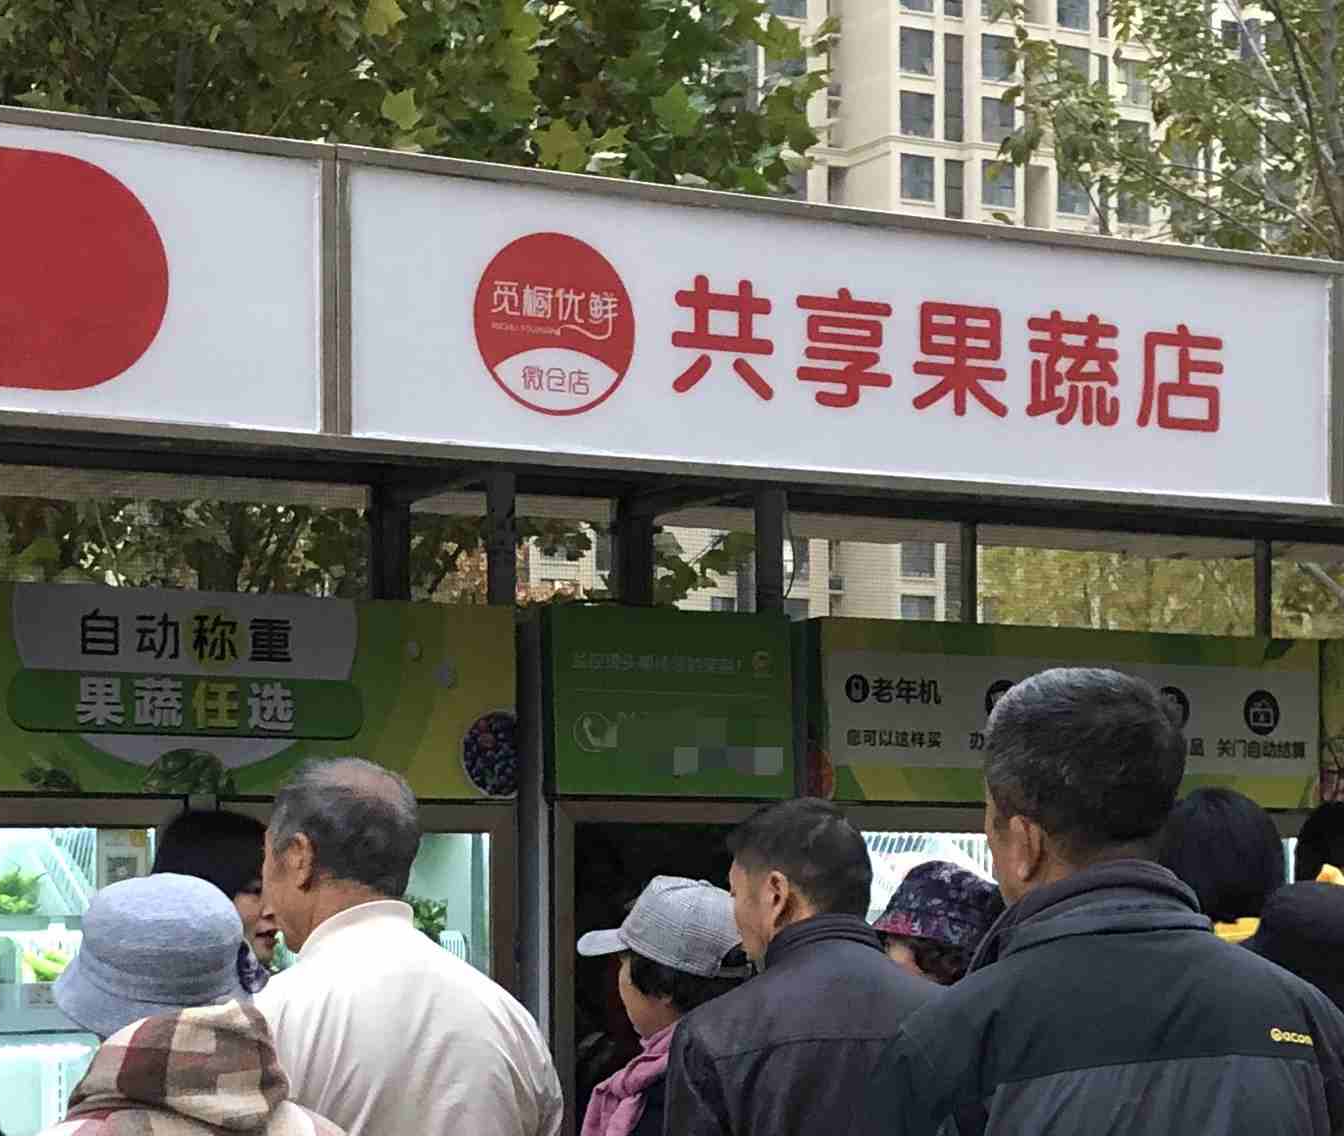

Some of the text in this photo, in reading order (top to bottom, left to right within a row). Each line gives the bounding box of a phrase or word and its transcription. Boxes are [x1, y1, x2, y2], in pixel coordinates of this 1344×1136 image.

[491, 281, 618, 326] 觅橱优鲜
[672, 275, 1223, 433] 共享果蔬店
[522, 365, 590, 396] 微仓店
[80, 608, 292, 662] 自动称重
[75, 674, 294, 732] 果蔬任选
[871, 674, 941, 705] 老年机
[1216, 738, 1306, 759] 关门自动结算
